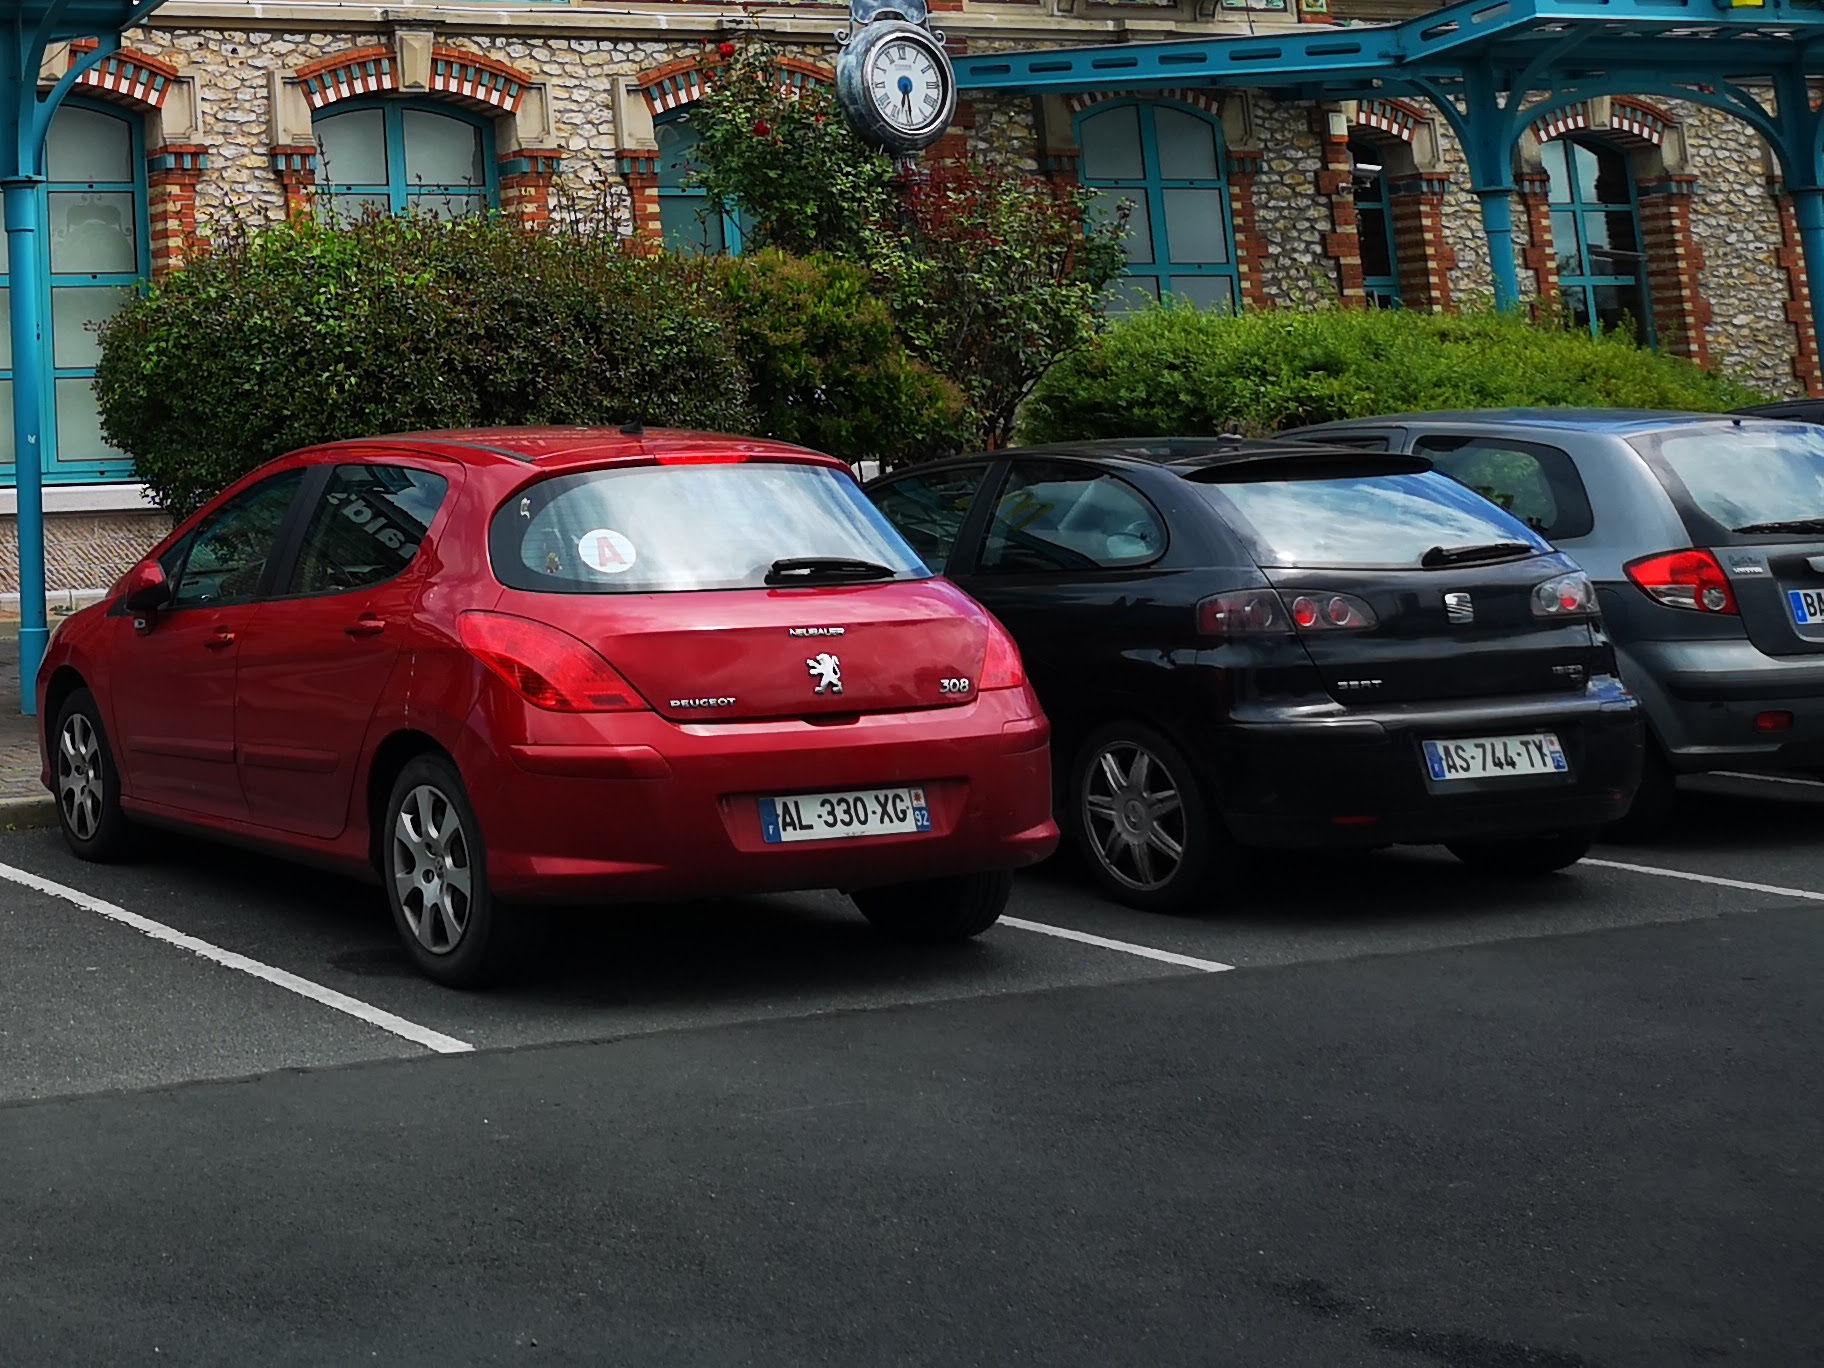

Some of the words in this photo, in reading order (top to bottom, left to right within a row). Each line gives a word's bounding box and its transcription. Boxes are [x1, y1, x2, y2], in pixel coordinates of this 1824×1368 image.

[597, 537, 627, 567] A
[940, 678, 969, 693] 308
[670, 698, 736, 707] PEUGEOT
[781, 794, 908, 832] AL-330-XG
[914, 810, 930, 826] 92
